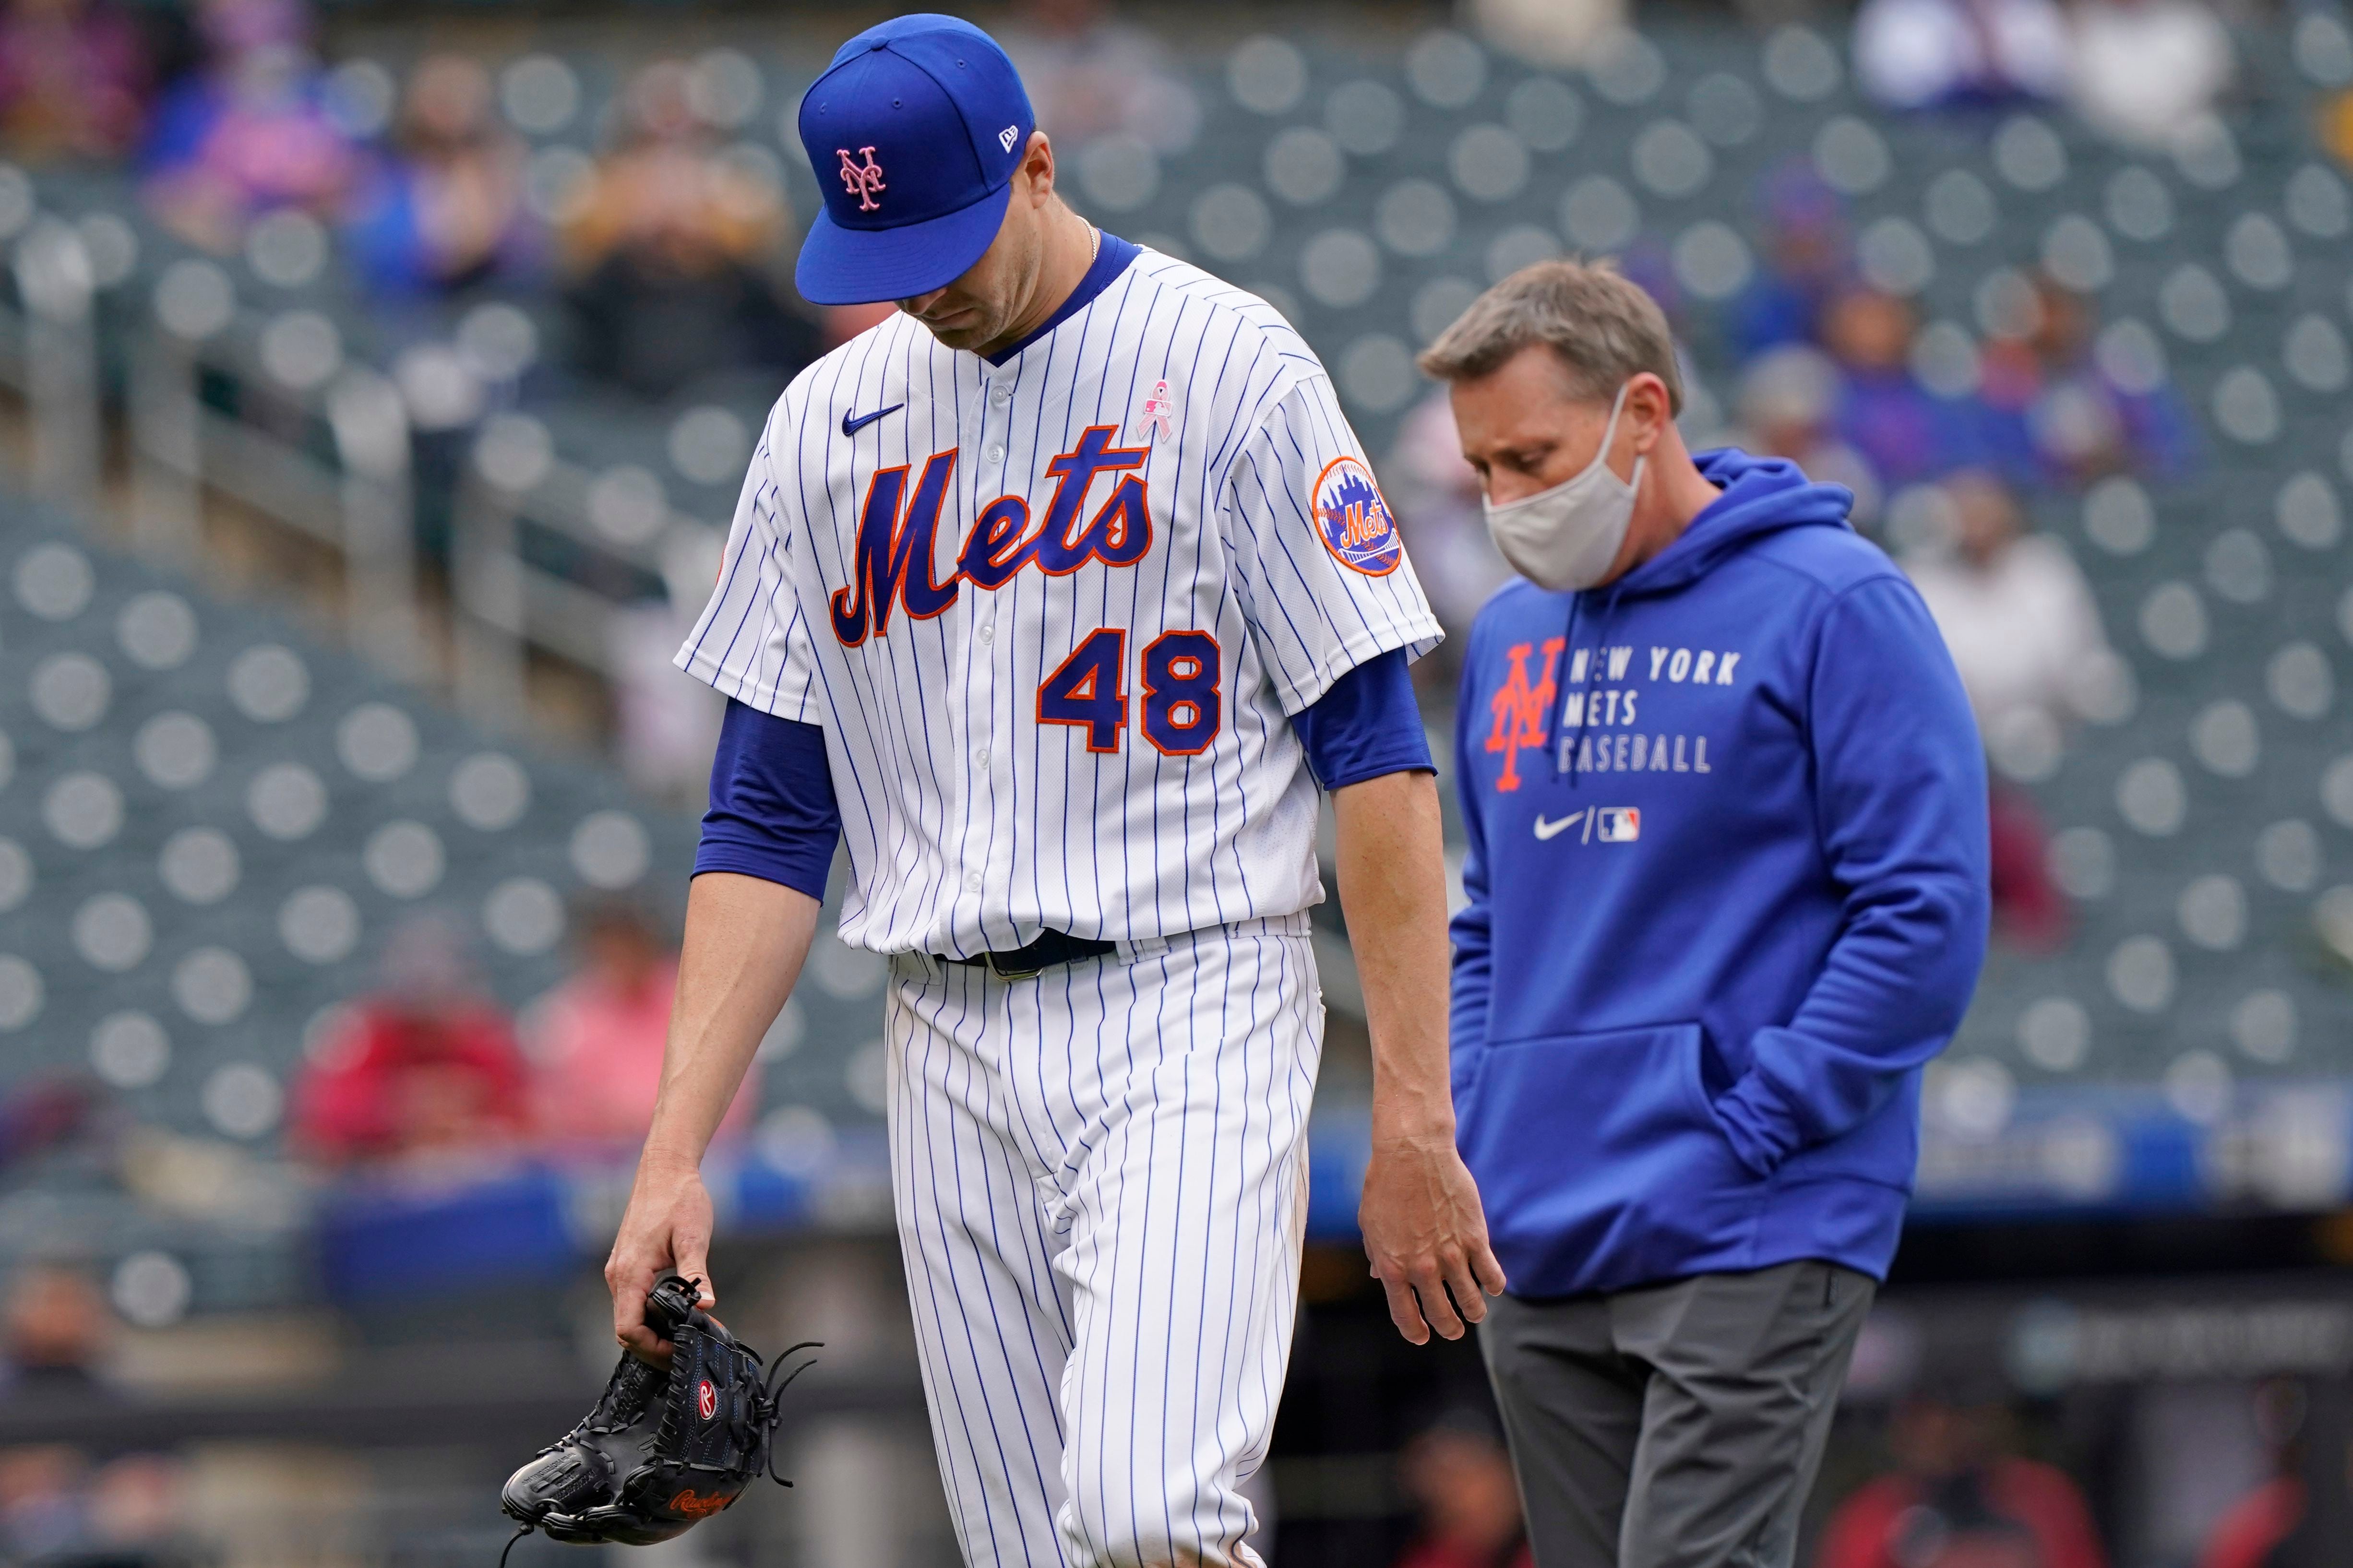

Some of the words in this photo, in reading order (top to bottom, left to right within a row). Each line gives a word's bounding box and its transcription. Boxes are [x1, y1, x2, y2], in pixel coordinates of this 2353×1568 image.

[831, 424, 1154, 648] Mets
[1340, 499, 1389, 549] Mets
[1649, 646, 1741, 685] YORK
[1036, 627, 1221, 757] 48
[1563, 689, 1638, 728] METS
[1557, 734, 1711, 774] BASEBALL
